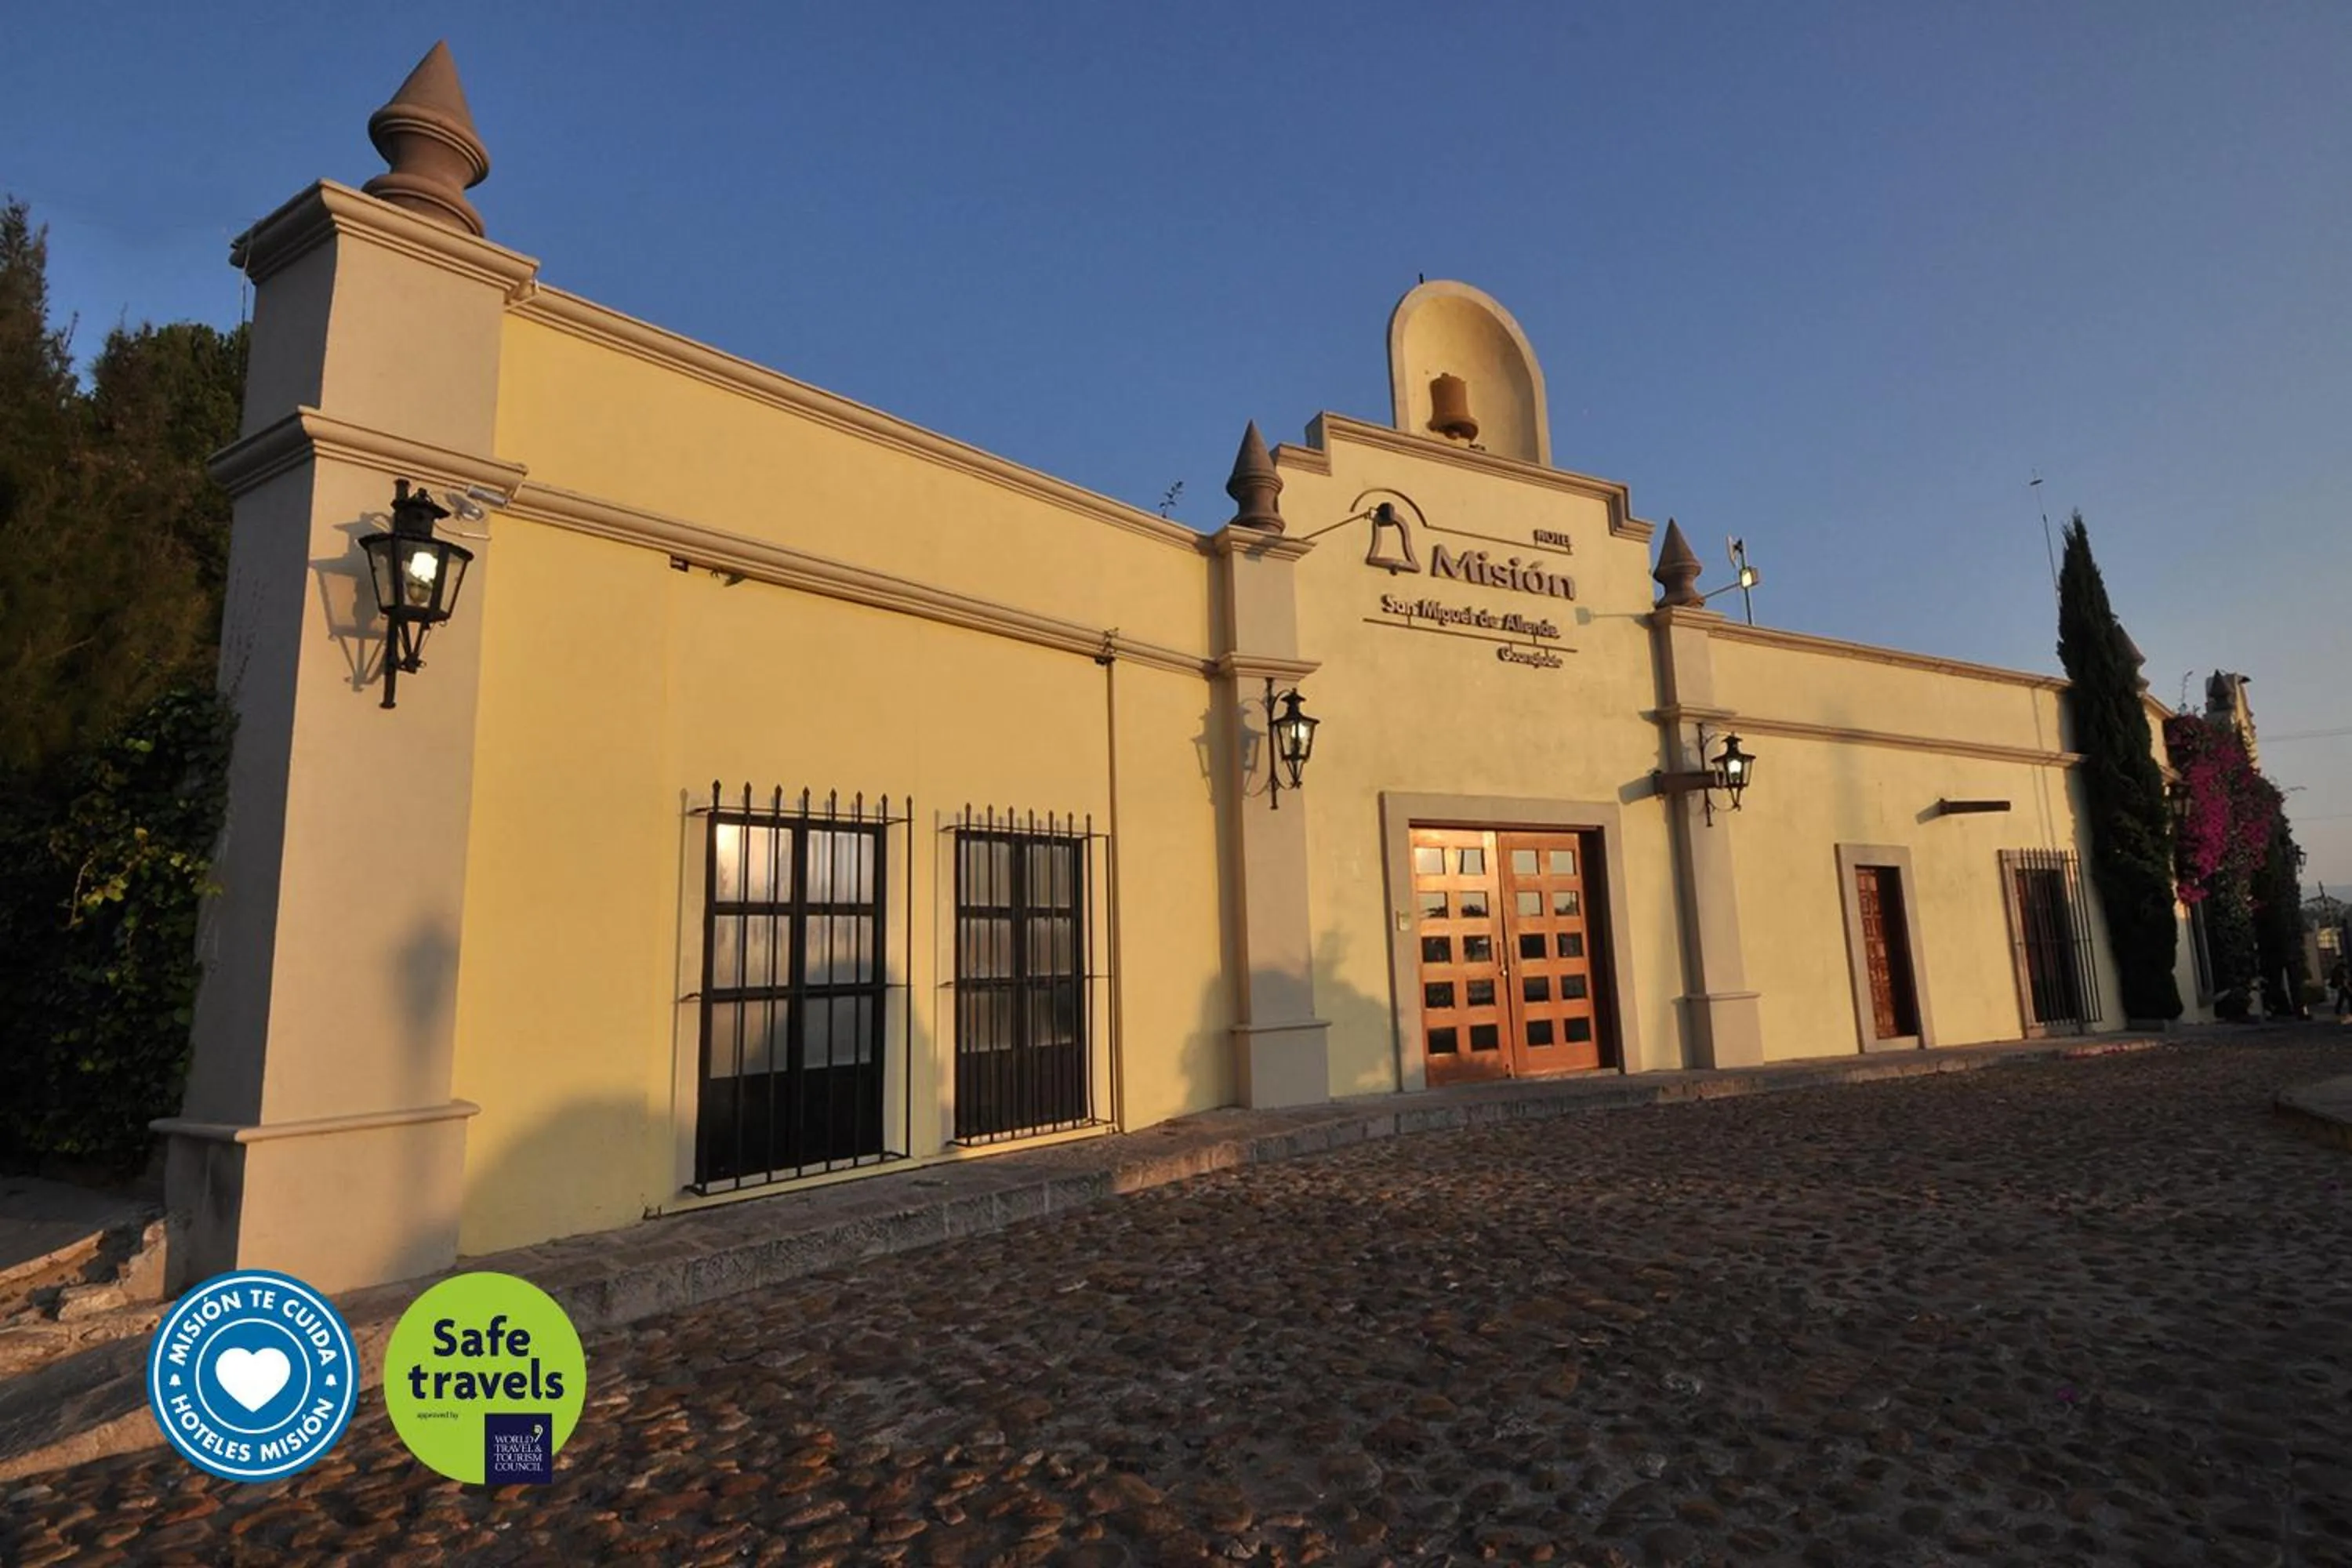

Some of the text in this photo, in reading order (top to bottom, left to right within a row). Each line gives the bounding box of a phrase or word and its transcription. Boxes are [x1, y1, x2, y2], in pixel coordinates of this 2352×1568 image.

[1430, 543, 1577, 601] Misión
[1381, 593, 1417, 615] San
[1417, 599, 1475, 626] Miguel
[1476, 608, 1501, 630] de
